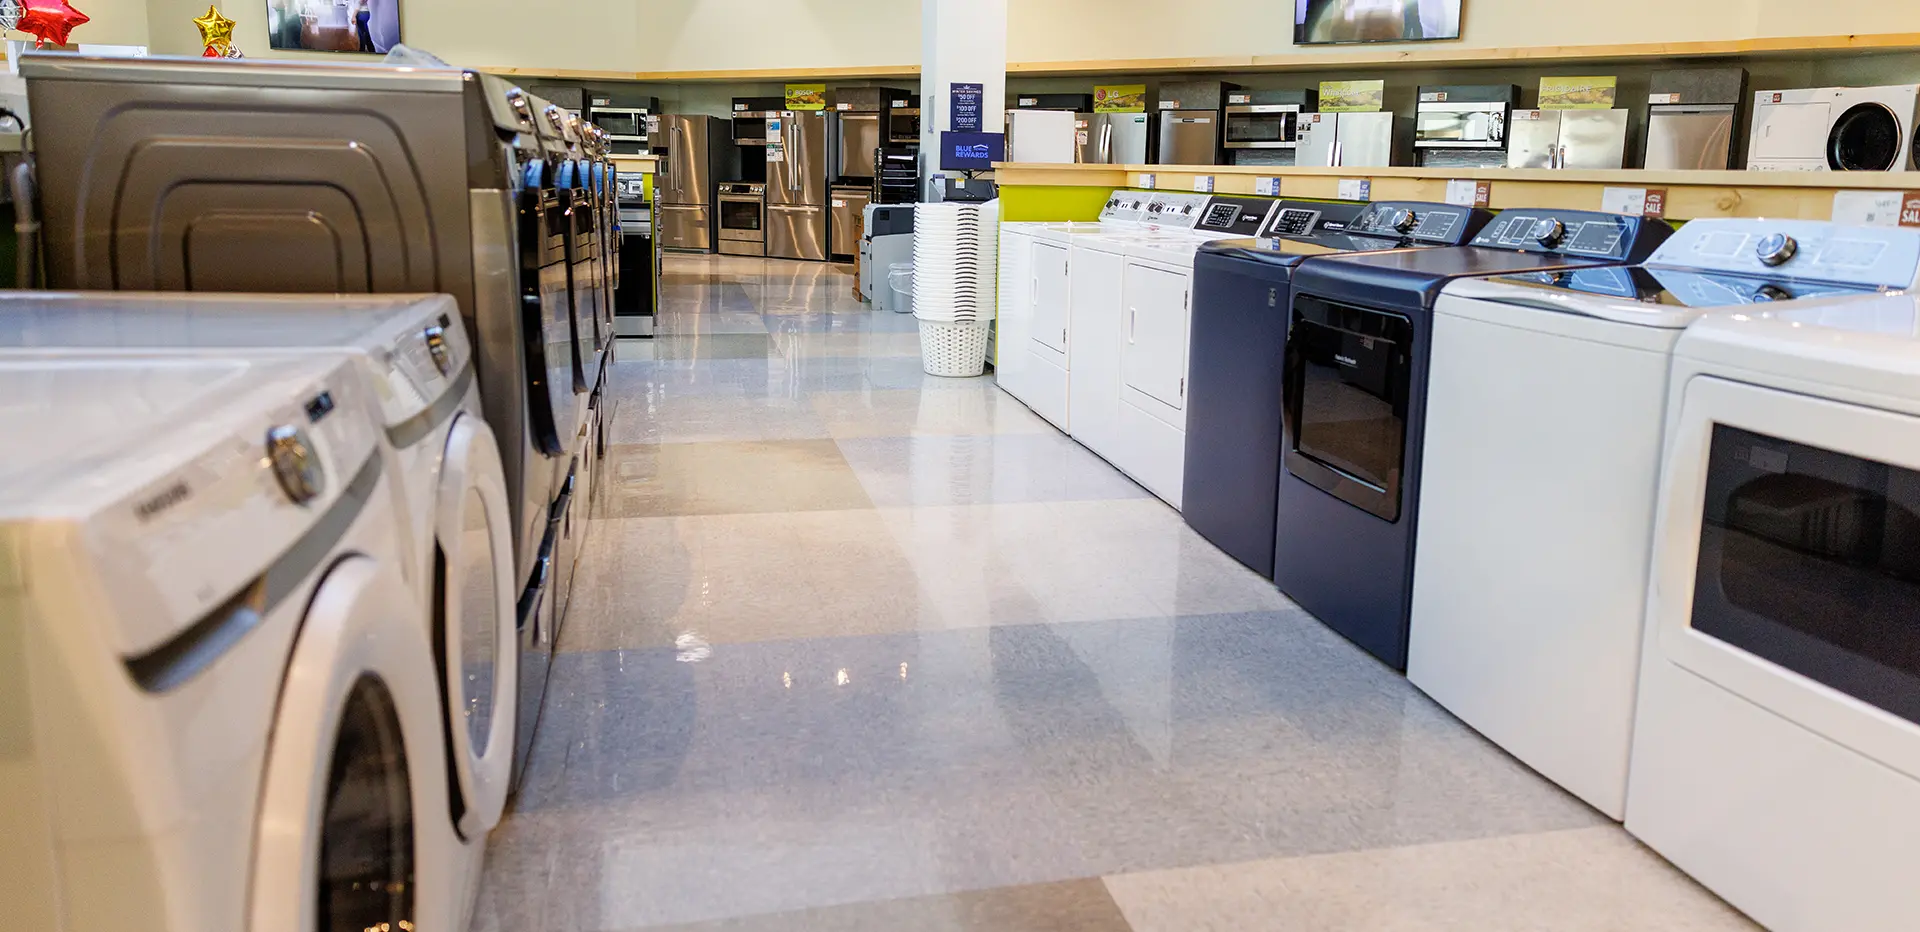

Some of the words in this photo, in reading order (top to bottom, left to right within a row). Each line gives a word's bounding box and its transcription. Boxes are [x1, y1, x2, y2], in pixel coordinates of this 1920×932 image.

[1108, 90, 1119, 98] LG
[955, 151, 989, 159] REWARDS
[1475, 193, 1488, 202] SALE
[1645, 202, 1661, 214] SALE
[1900, 209, 1920, 223] SAL
